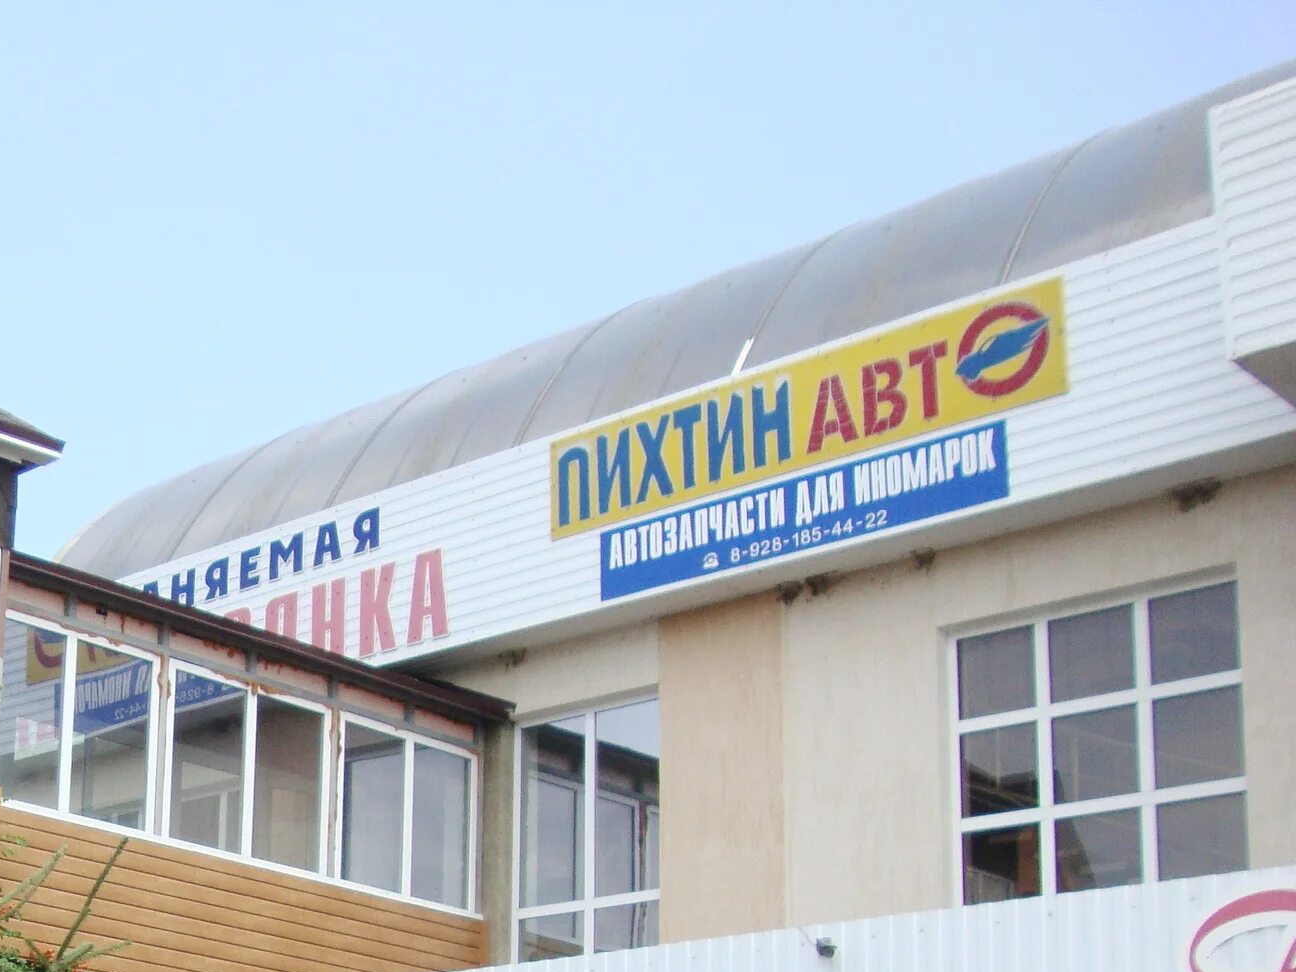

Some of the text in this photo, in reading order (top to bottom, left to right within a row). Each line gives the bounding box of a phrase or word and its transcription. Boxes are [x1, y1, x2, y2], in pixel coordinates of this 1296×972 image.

[557, 379, 793, 528] ПИХТИН
[608, 427, 997, 571] АВТОЗАПЧАСТИ ДЛЯ ИНОМАРОК
[729, 508, 888, 565] 8-928-185-44-22
